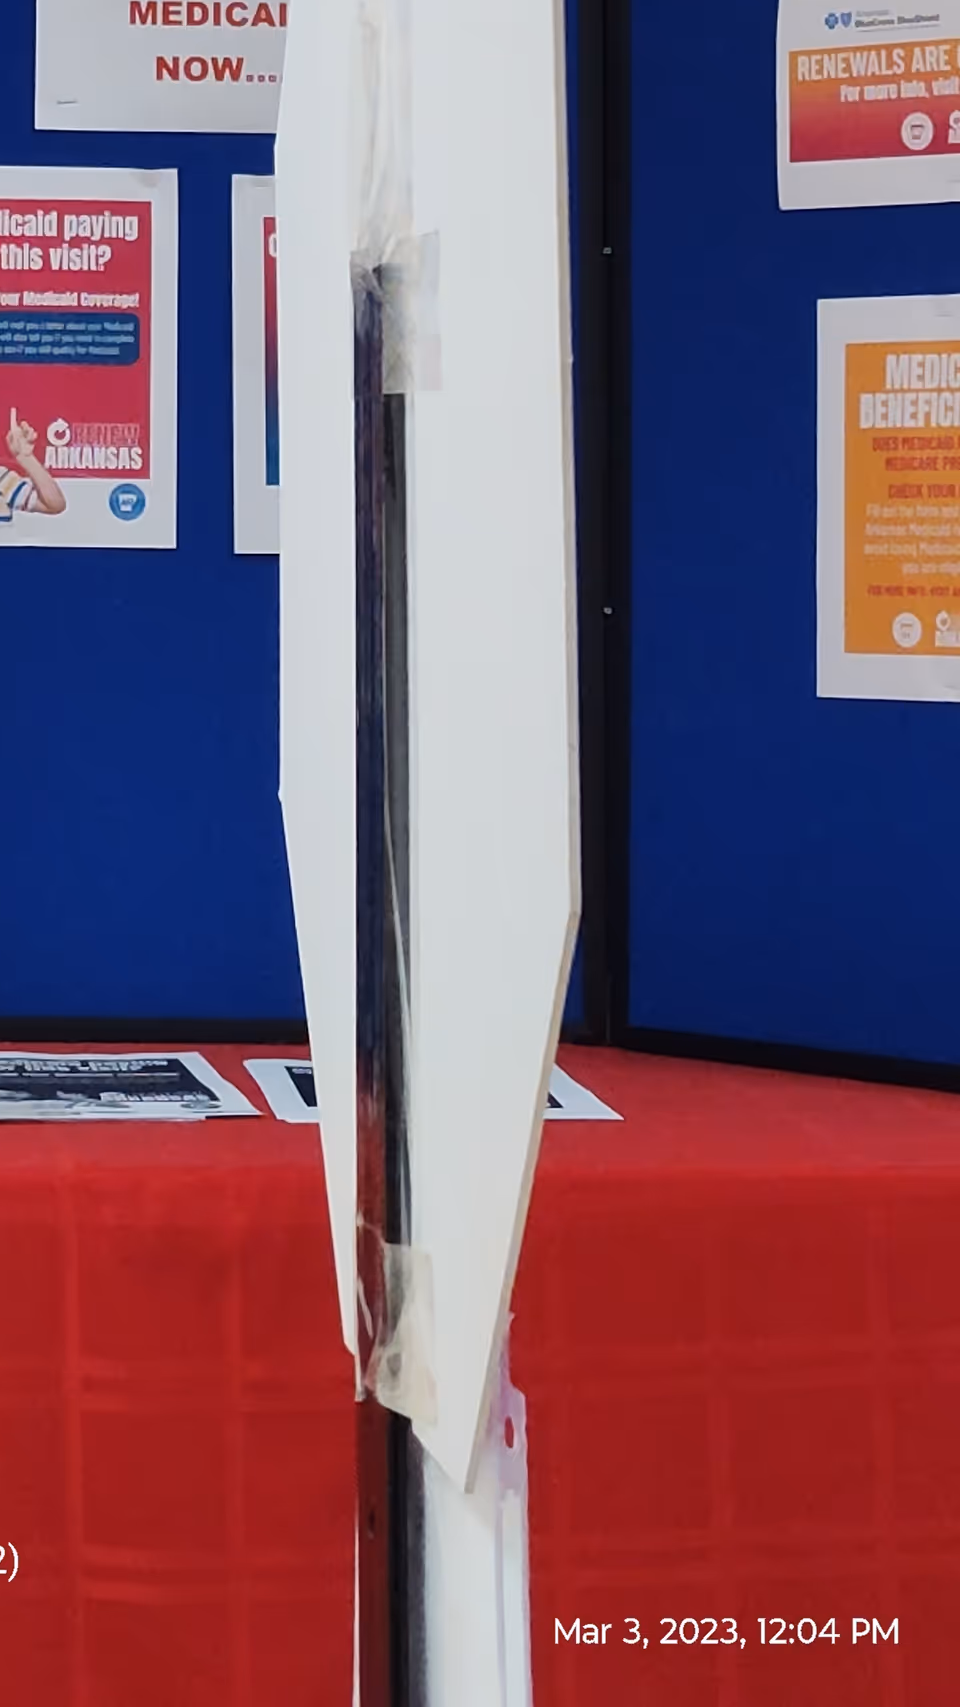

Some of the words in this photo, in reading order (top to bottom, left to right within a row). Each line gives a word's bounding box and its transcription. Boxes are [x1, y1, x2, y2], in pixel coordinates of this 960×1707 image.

[797, 48, 905, 81] RENEWALS
[912, 45, 951, 73] ARE
[63, 211, 138, 241] paying
[0, 243, 44, 270] this
[49, 243, 112, 272] visit?
[886, 354, 960, 389] MEDIC
[45, 444, 143, 470] ARKANSAS
